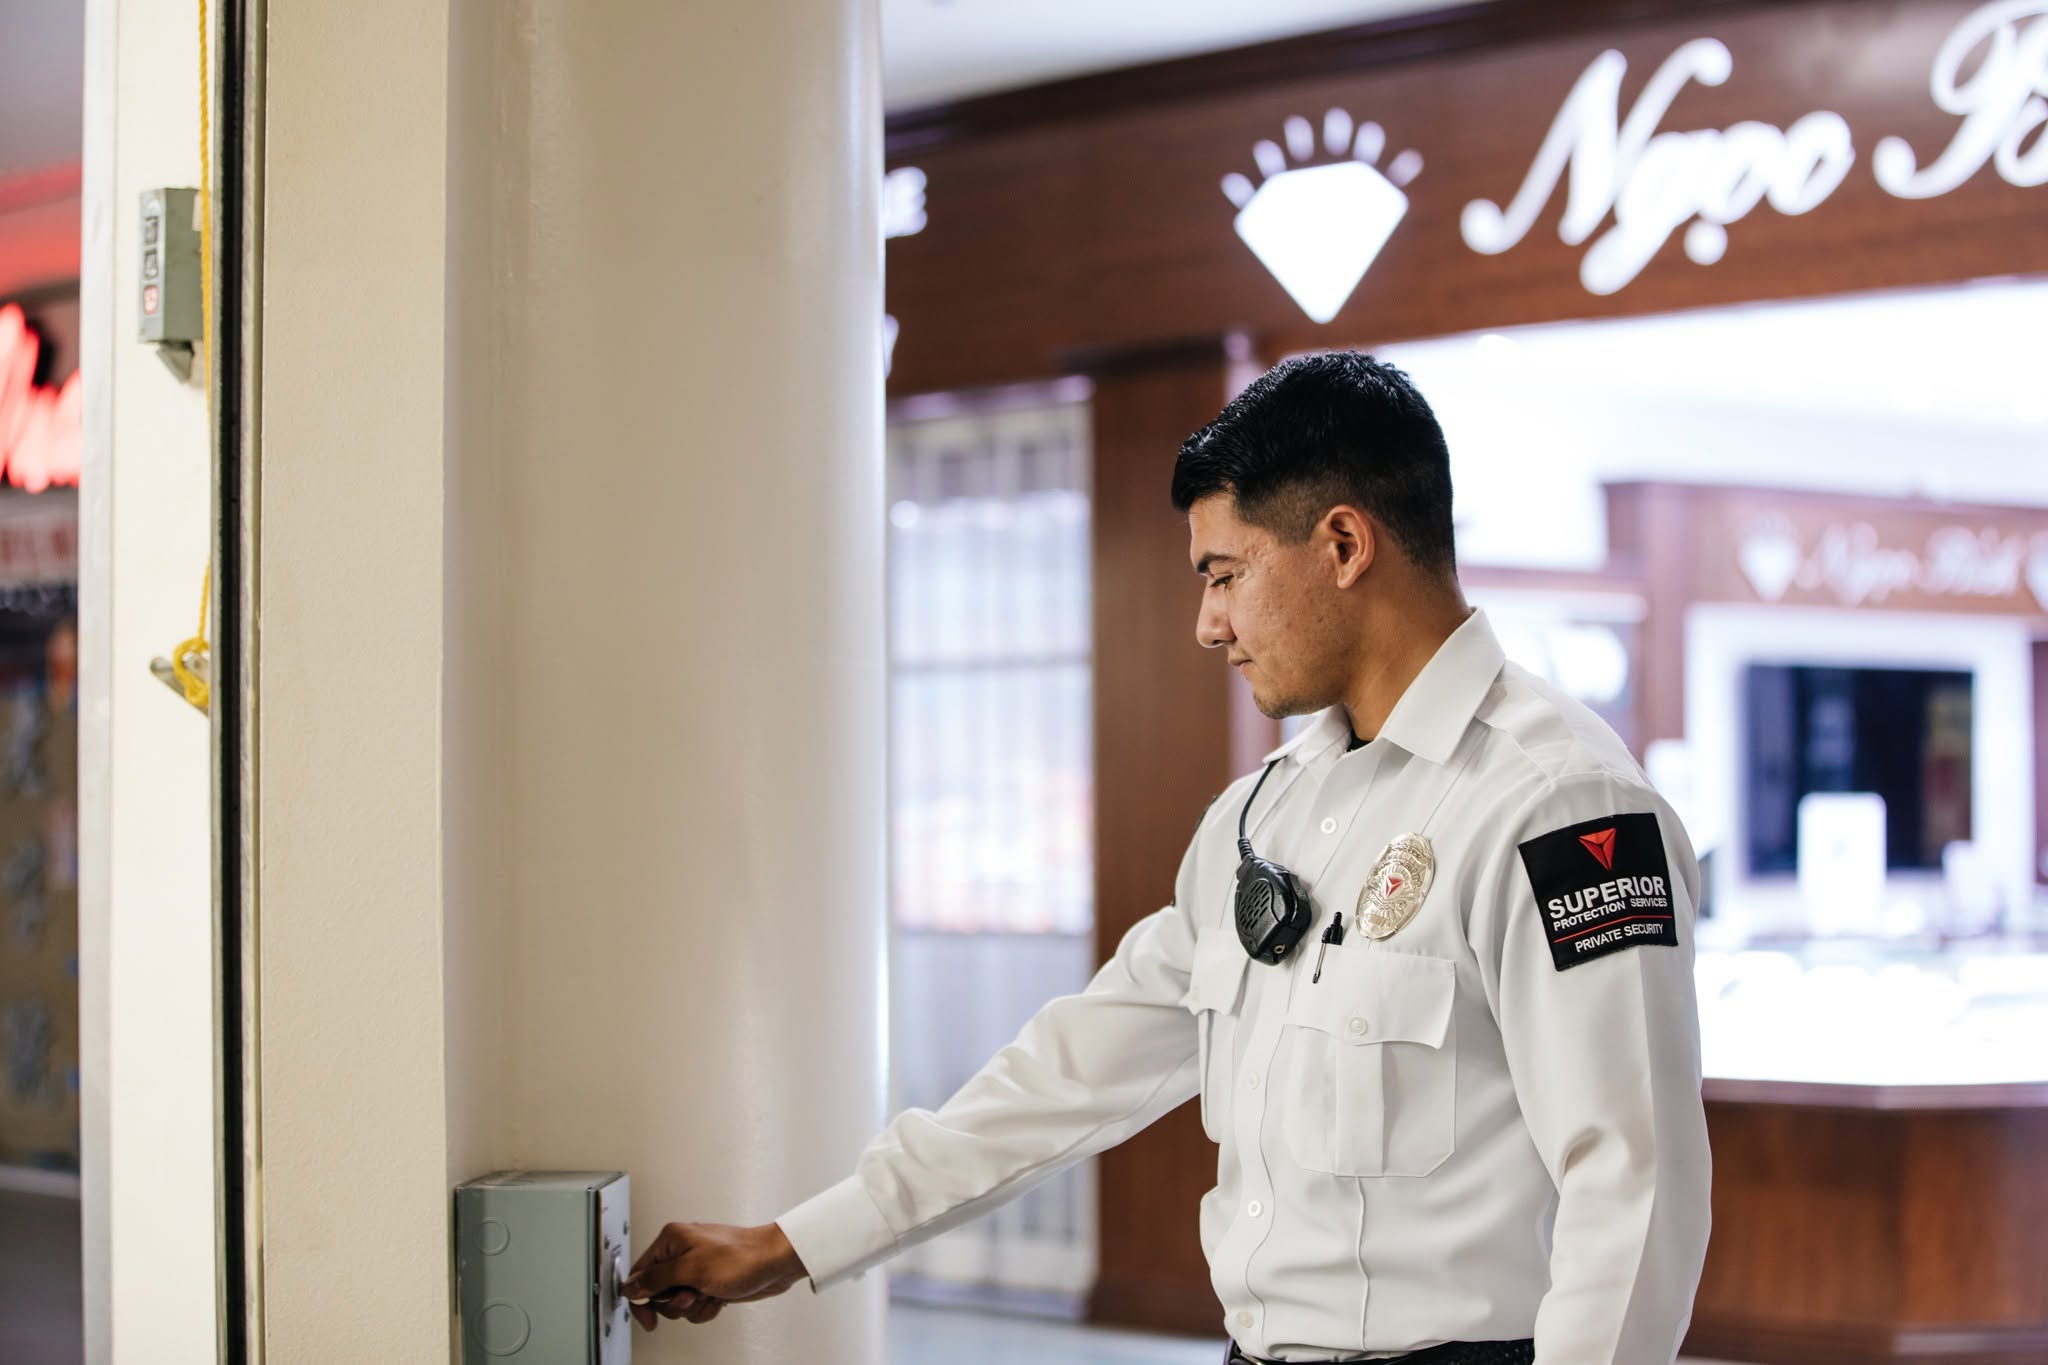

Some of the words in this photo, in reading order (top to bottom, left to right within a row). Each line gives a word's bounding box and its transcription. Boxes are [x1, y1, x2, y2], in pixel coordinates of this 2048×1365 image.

[1548, 876, 1666, 919] SUPERIOR
[1553, 901, 1626, 931] PROTECTION
[1630, 898, 1667, 907] SERVICES
[1575, 930, 1623, 952] PRIVATE
[1625, 924, 1663, 936] SECURITY
